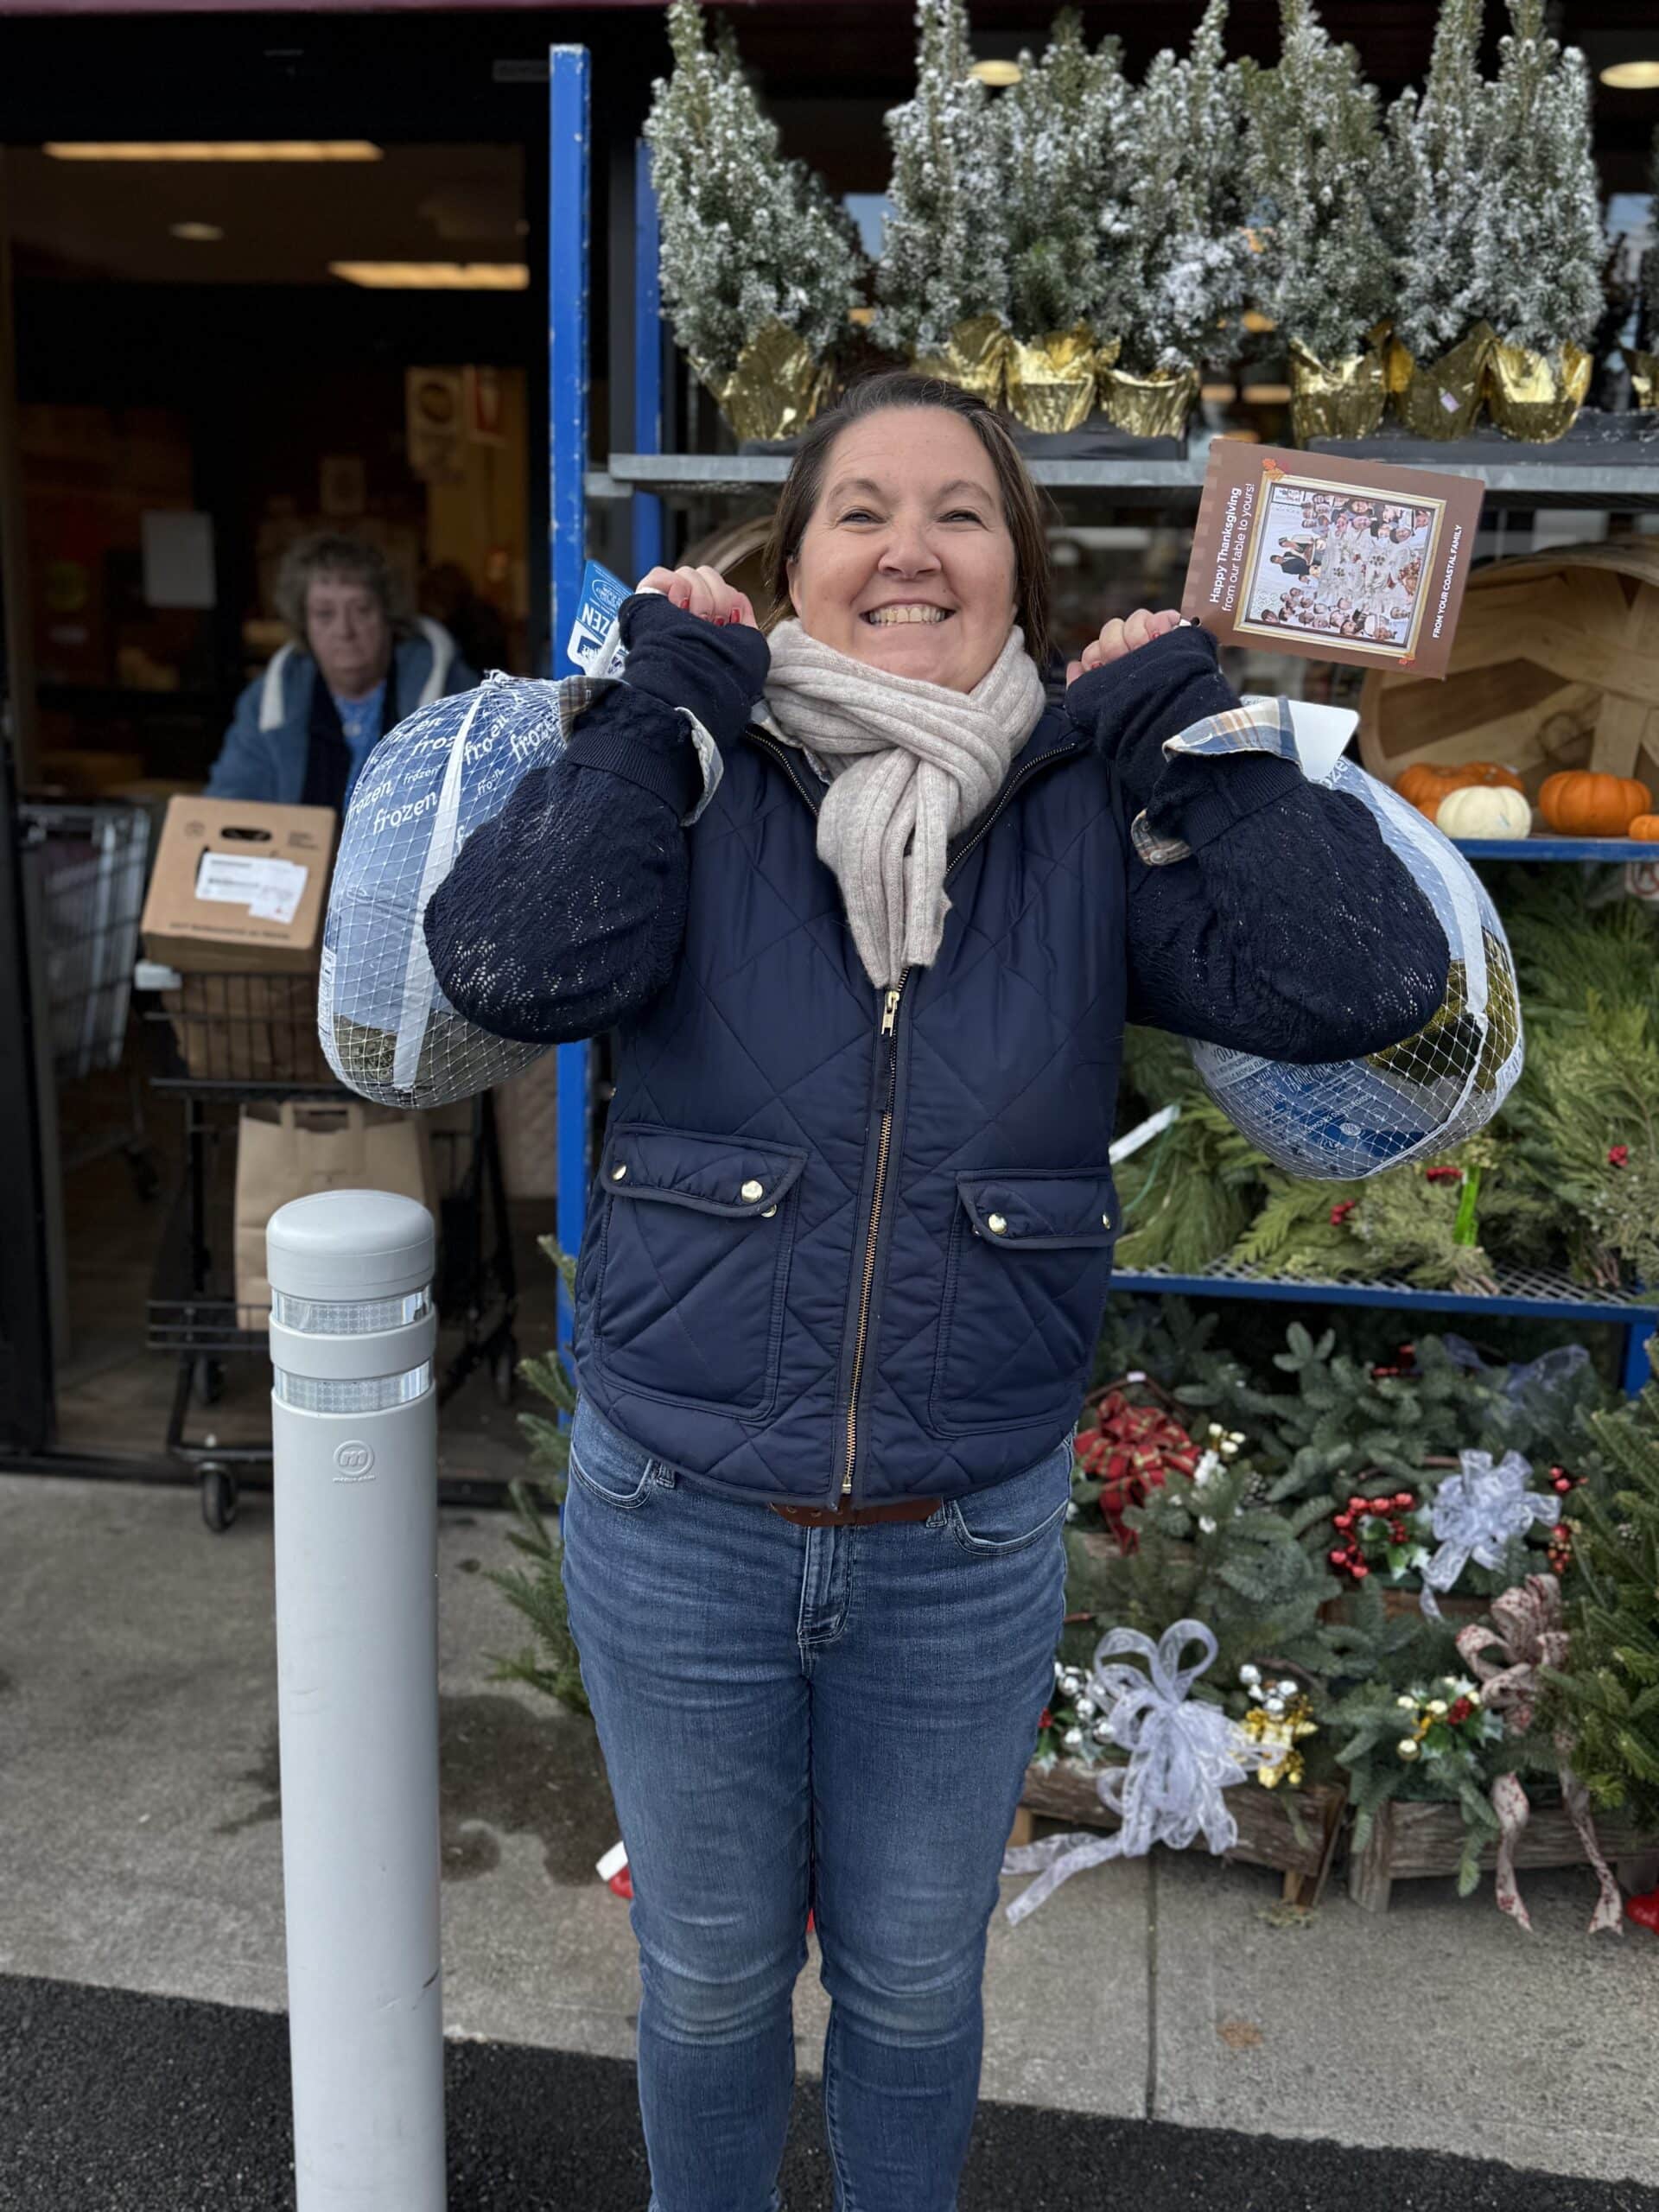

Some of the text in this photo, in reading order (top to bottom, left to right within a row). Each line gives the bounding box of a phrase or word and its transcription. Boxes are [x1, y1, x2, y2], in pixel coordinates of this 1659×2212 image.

[1209, 486, 1242, 603] Happy Thanksgiving
[1222, 483, 1255, 612] from our table to yours!
[1433, 524, 1462, 639] FROM YOUR COASTAL FAMILY
[582, 602, 611, 637] ZEN
[410, 734, 457, 757] froz
[464, 715, 510, 766] froen
[403, 767, 439, 785] frozen
[372, 791, 438, 836] frozen
